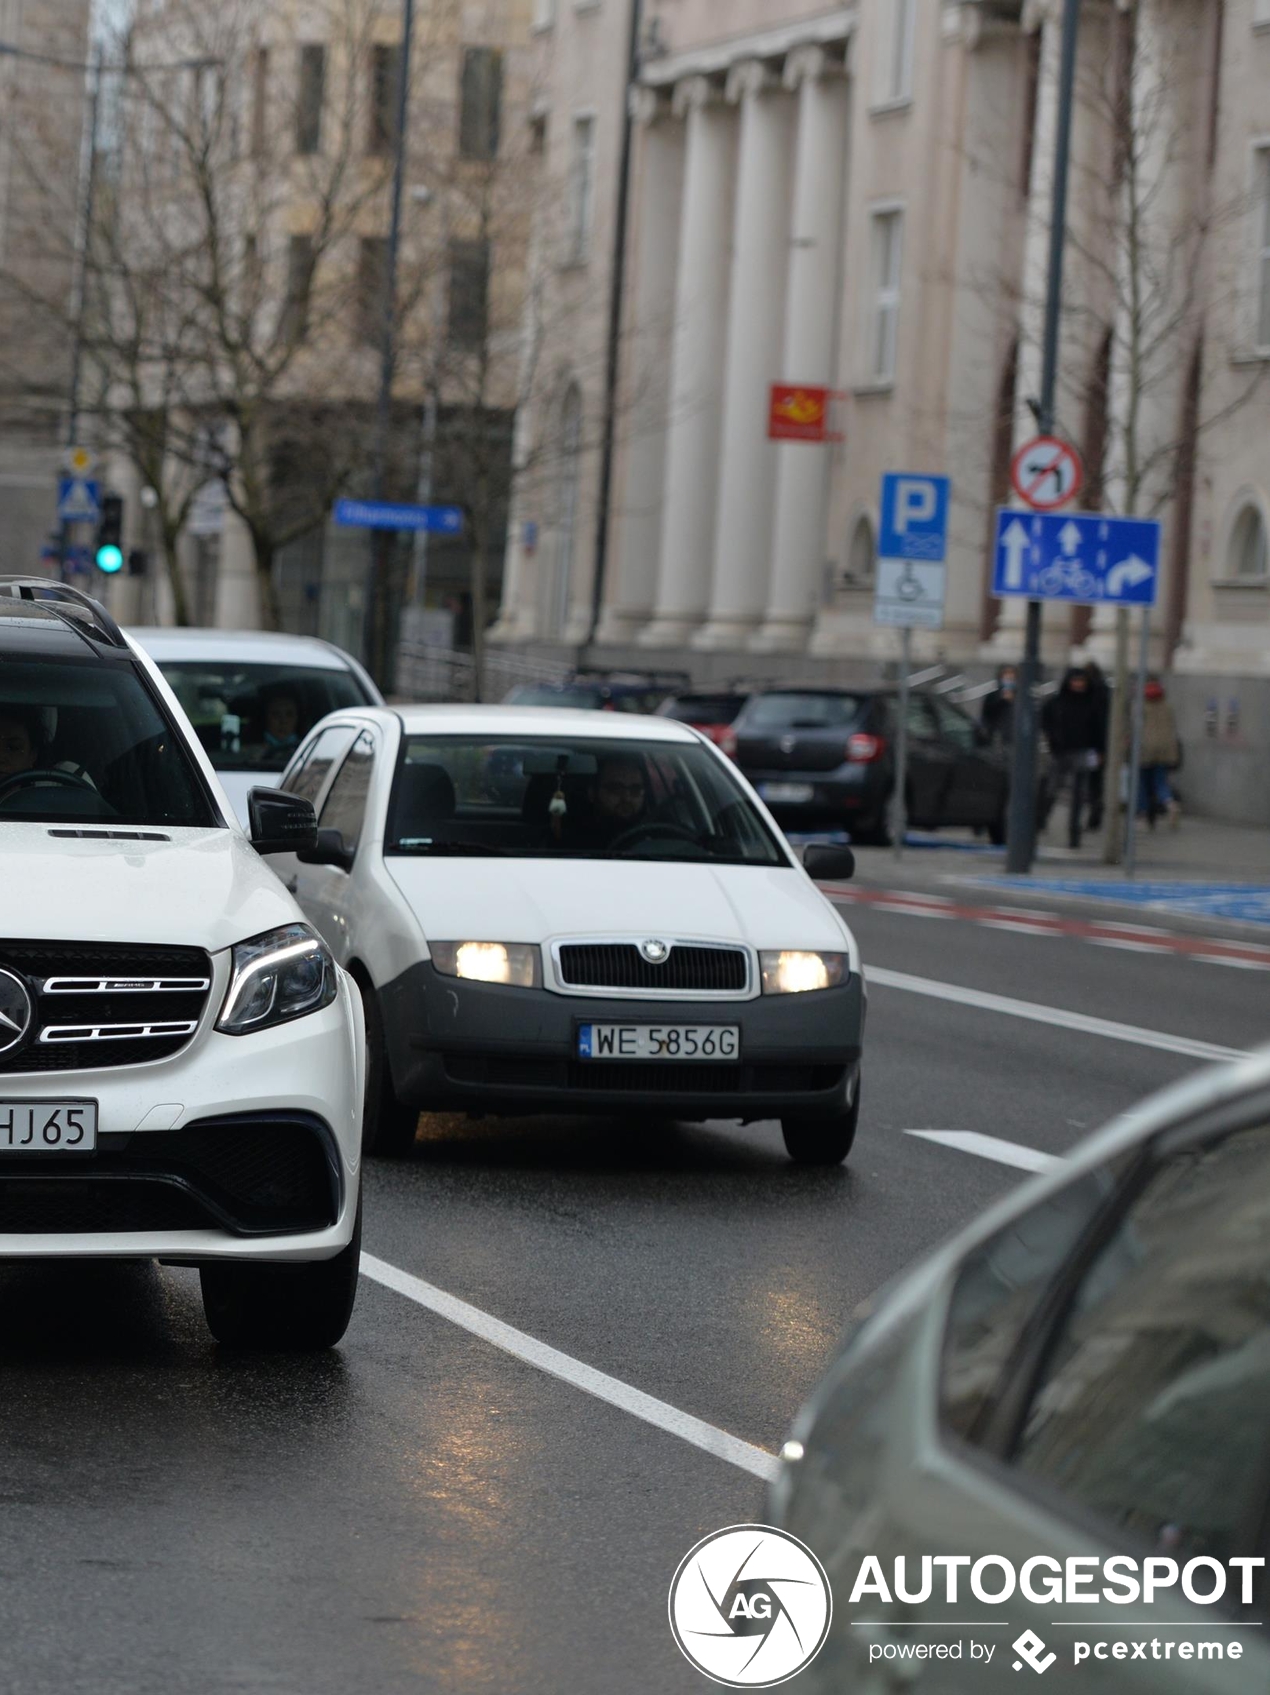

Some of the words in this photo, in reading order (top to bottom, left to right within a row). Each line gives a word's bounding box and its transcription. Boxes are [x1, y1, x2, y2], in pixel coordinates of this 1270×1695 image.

[894, 480, 937, 535] P
[597, 1028, 636, 1054] WE
[649, 1029, 735, 1056] 5856G
